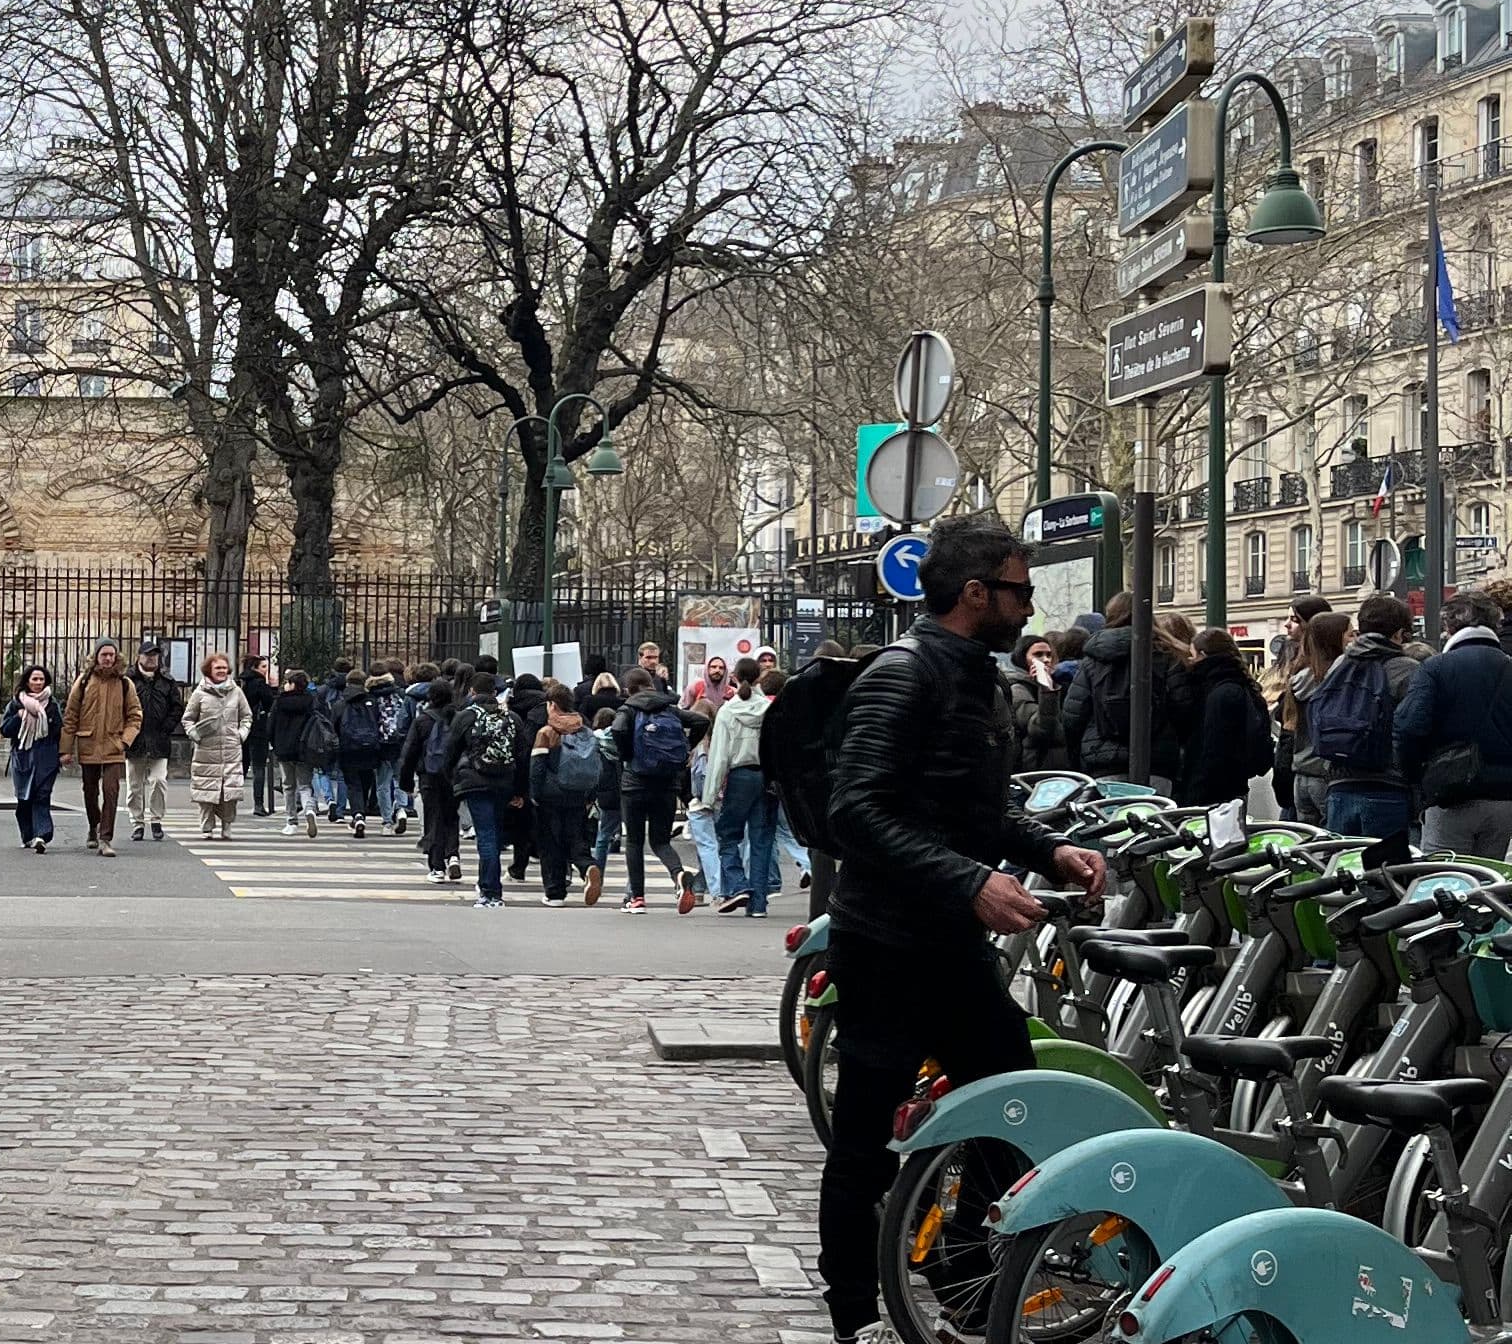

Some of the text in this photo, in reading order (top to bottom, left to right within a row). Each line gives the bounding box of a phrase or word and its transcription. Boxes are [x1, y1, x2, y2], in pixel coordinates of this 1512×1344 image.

[1138, 327, 1157, 346] Saint
[1158, 316, 1185, 339] Séverin
[1146, 359, 1154, 374] de
